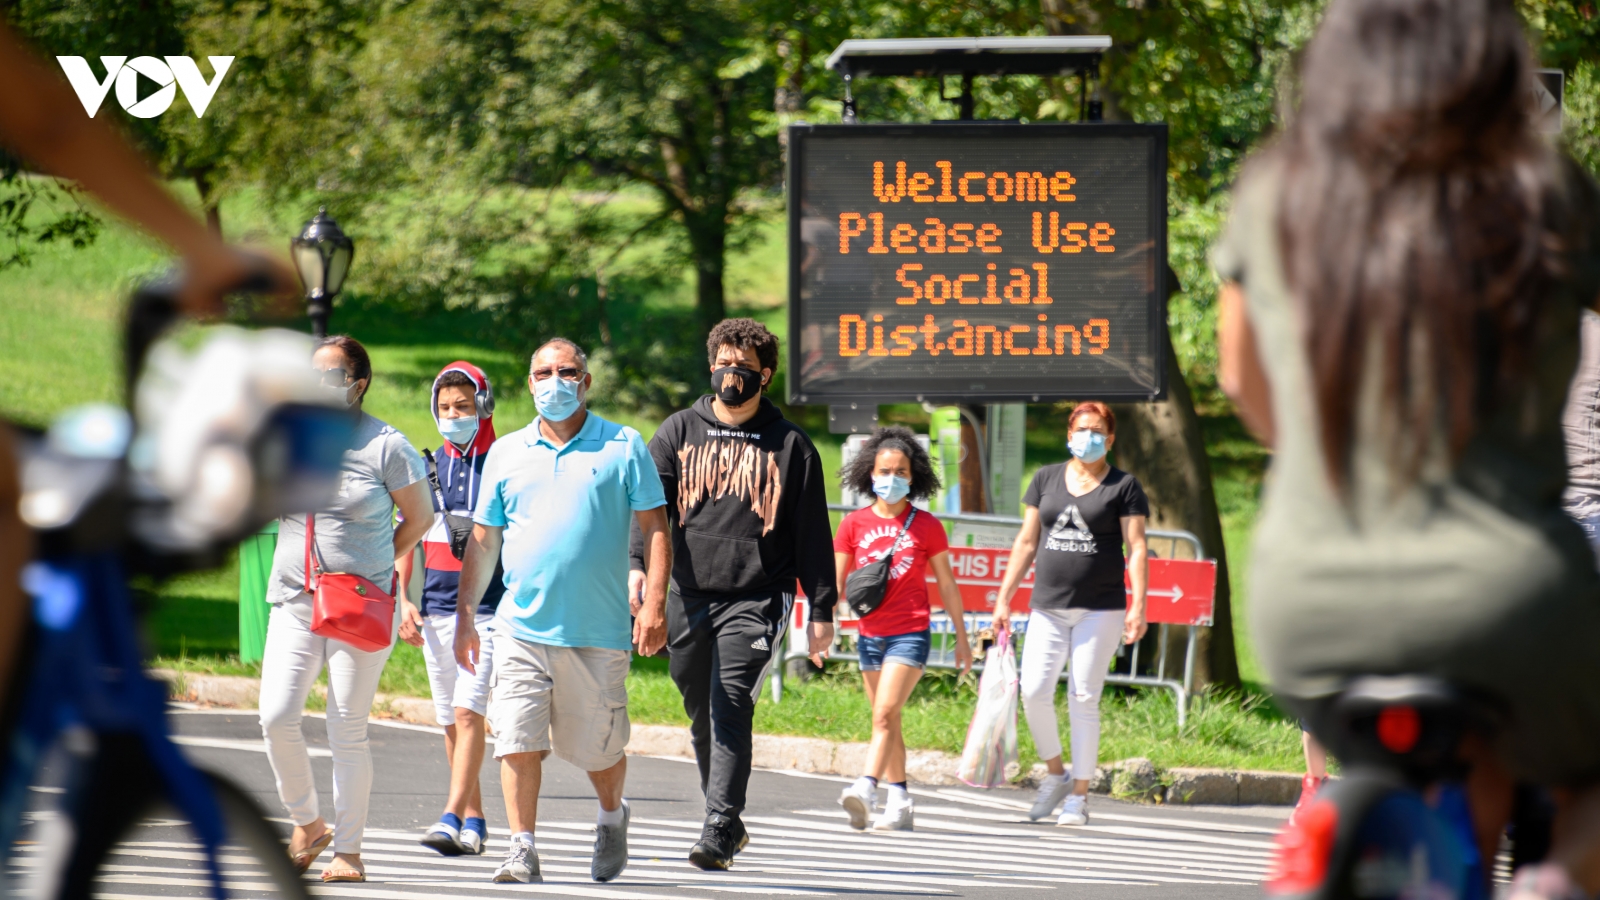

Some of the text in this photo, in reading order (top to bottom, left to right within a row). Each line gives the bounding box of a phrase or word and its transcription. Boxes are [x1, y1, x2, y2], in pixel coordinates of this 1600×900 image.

[873, 160, 1077, 203] Welcome
[839, 211, 1116, 254] Please Use
[895, 262, 1054, 305] Social
[838, 313, 1110, 357] Distancing
[948, 553, 990, 578] HIS
[1045, 537, 1099, 554] Reebok
